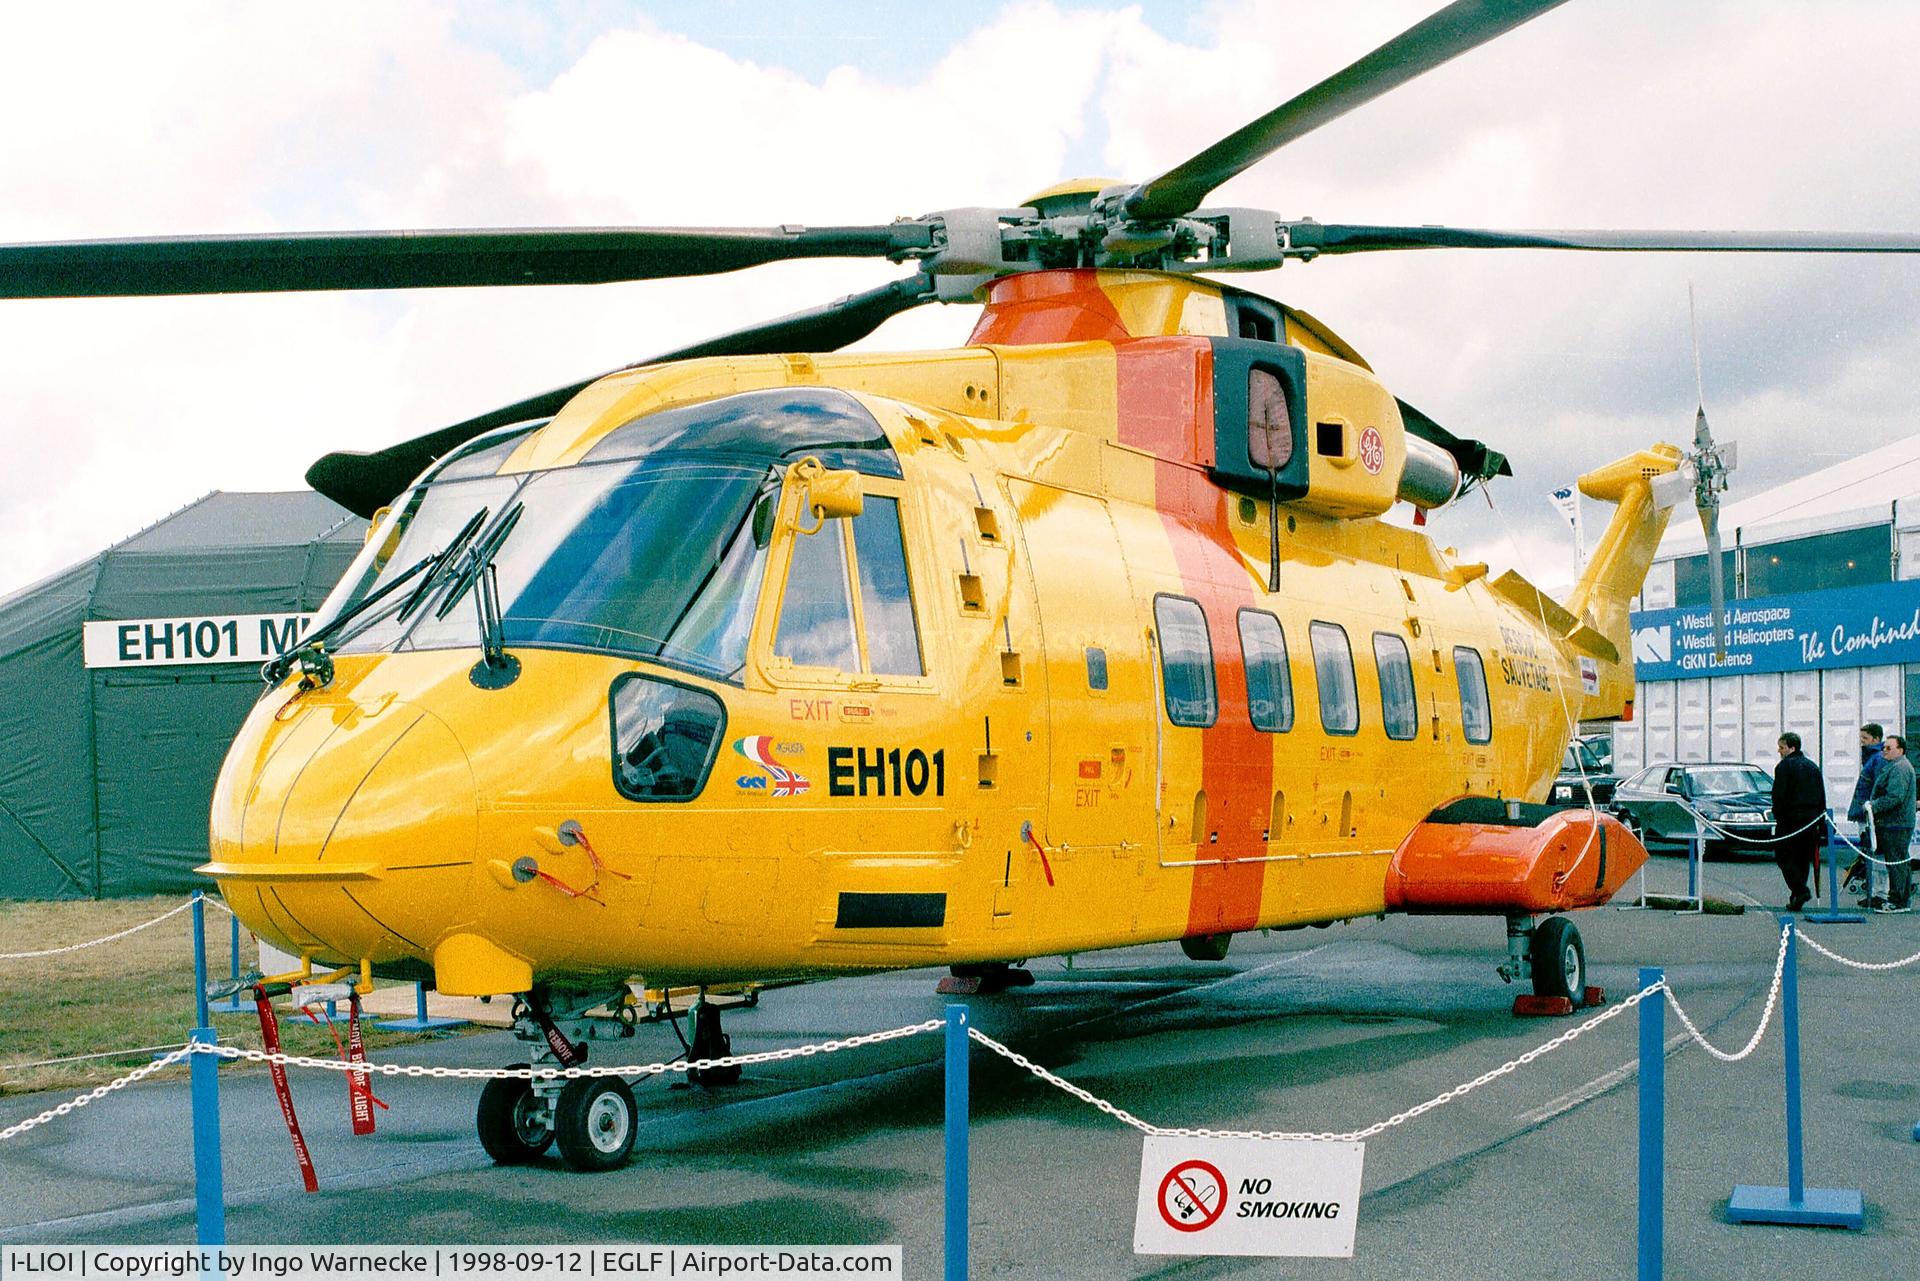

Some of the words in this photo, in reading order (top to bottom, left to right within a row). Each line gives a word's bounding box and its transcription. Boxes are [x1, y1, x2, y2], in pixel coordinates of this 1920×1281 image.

[1683, 611, 1731, 630] Westld
[1733, 607, 1791, 626] Aerospace
[118, 619, 238, 661] EH101
[260, 616, 312, 656] M
[1631, 625, 1671, 664] KN
[1683, 630, 1731, 650] Westlad
[1734, 627, 1795, 647] Helicopters
[1798, 631, 1826, 664] The
[1831, 607, 1920, 656] Combined
[1682, 653, 1707, 670] GKN
[790, 698, 833, 721] EXIT
[828, 747, 945, 797] EH101
[1075, 788, 1102, 807] EXIT
[548, 1029, 574, 1060] REMOVE
[1239, 1178, 1272, 1195] NO
[1236, 1201, 1340, 1219] SMOKING
